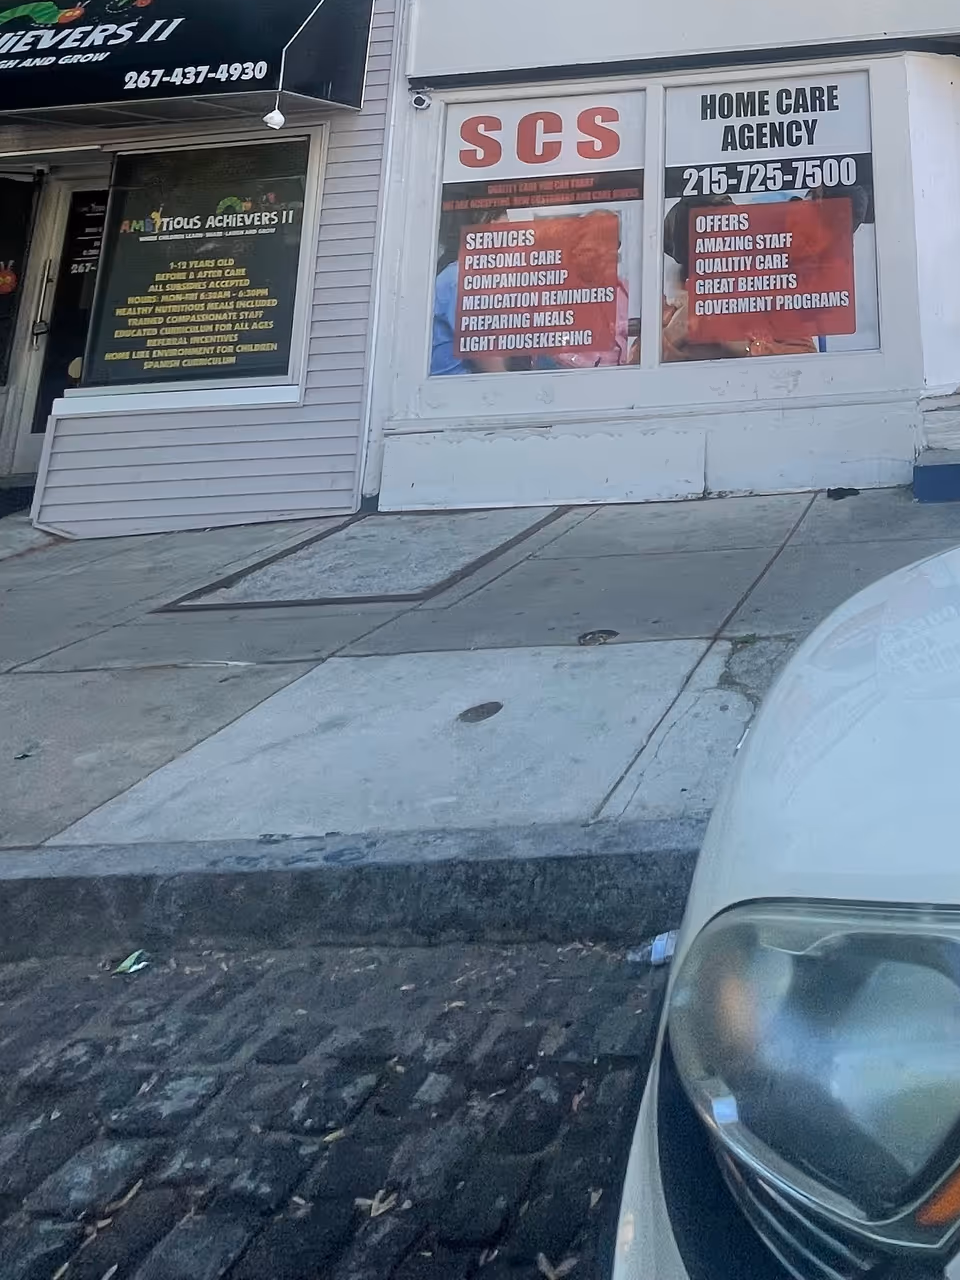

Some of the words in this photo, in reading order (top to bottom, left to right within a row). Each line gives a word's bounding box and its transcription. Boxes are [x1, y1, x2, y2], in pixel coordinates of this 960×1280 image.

[17, 56, 56, 67] AND
[58, 52, 110, 65] GROW
[123, 61, 268, 89] 267-437-4930
[701, 90, 770, 120] HOME
[776, 85, 839, 115] CARE
[459, 106, 620, 168] SCS
[721, 119, 818, 151] AGENCY
[682, 157, 857, 197] 215-725-7500
[695, 213, 749, 233] OFFERS
[466, 229, 535, 250] SERVICES
[695, 235, 753, 253] AMAZING
[755, 233, 793, 249] STAFF
[189, 259, 214, 268] YEARS
[217, 258, 234, 266] OLD
[465, 252, 527, 270] PERSONAL
[530, 250, 562, 266] CARE
[695, 255, 753, 275] QUALITIY
[755, 253, 789, 270] CARE
[197, 270, 222, 278] AFTER
[225, 268, 246, 277] CARE
[463, 270, 568, 290] COMPANIONSHIP
[148, 284, 163, 292] ALL
[208, 279, 249, 288] ACCEPTED
[695, 277, 736, 295] GREAT
[737, 274, 798, 292] BENEFITS
[116, 307, 153, 316] HEALTHY
[155, 304, 204, 314] NUTRITIOUS
[207, 301, 234, 310] MEALS
[236, 299, 278, 308] INCLUDED
[462, 291, 539, 311] MEDICATION
[541, 287, 614, 305] REMINDERS
[695, 296, 774, 316] GOVERMENT
[776, 291, 850, 310] PROGRAMS
[166, 312, 237, 324] COMPASSIONATE
[240, 311, 264, 319] STAFF
[215, 324, 232, 332] FOR
[234, 322, 249, 330] ALL
[252, 321, 274, 329] AGES
[461, 312, 531, 331] PREPARING
[533, 310, 574, 327] MEALS
[217, 345, 234, 354] FOR
[236, 343, 278, 353] CHILDREN
[460, 335, 496, 352] LIGHT
[498, 330, 592, 350] HOUSEKEEPING
[143, 360, 180, 369] SPANISH
